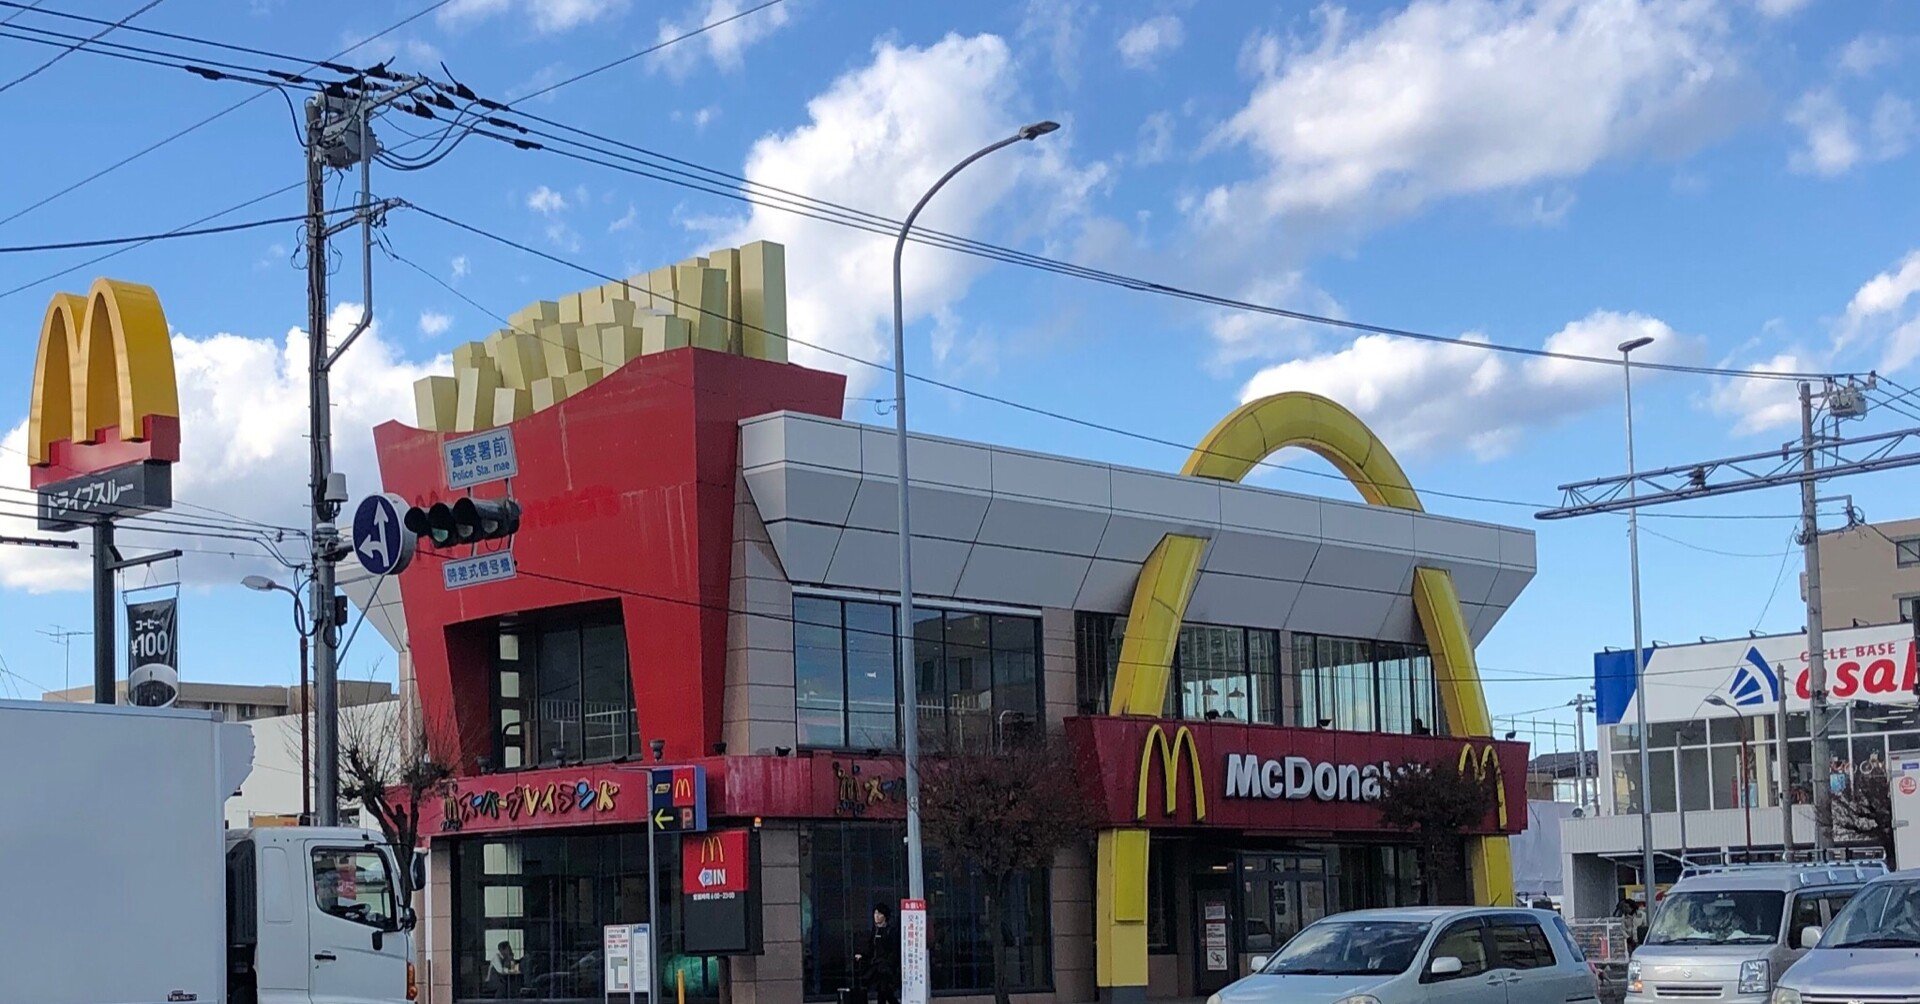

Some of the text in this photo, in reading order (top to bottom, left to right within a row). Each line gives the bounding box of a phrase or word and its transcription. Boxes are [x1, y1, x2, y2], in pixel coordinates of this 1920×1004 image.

[450, 436, 508, 468] 警察署前
[452, 460, 510, 482] Police Sta. mae
[47, 479, 134, 518] ドライブスルー
[446, 557, 511, 583] 時差式信号機
[135, 618, 160, 631] コーヒー
[131, 631, 168, 657] ¥100
[1800, 643, 1896, 662] CCLE BASE
[713, 868, 726, 885] IN
